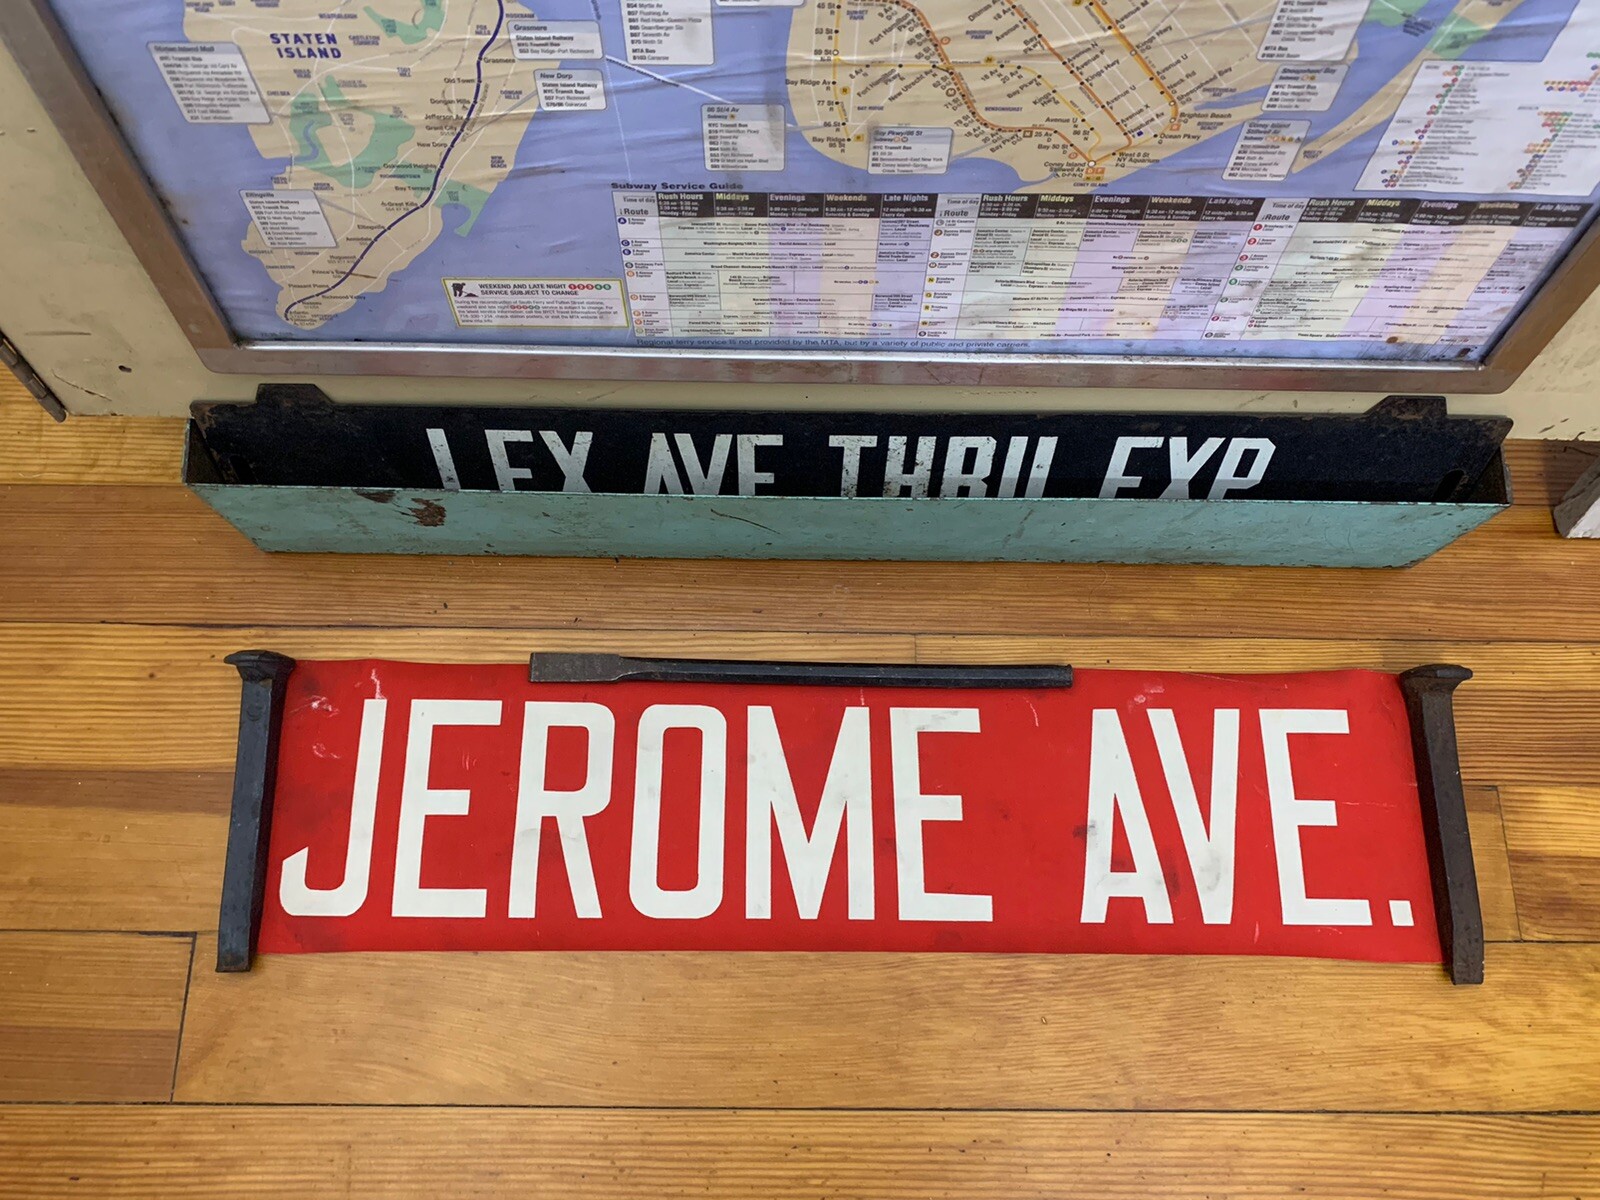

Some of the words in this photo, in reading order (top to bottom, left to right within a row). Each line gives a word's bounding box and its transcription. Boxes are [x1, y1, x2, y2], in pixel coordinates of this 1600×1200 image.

[1115, 6, 1141, 25] Avenue
[269, 33, 338, 45] STATEN
[1136, 34, 1156, 50] Kings
[277, 47, 342, 59] ISLAND
[1156, 59, 1181, 76] Avenue
[1085, 68, 1105, 83] Kings
[800, 79, 822, 87] Ridge
[1019, 77, 1038, 92] Pkwy
[1032, 92, 1052, 106] Kings
[1179, 112, 1208, 120] Brighton
[1044, 161, 1062, 169] Coney
[610, 182, 658, 191] Subway
[661, 182, 707, 190] Service
[709, 182, 744, 190] Guide
[715, 193, 750, 201] Middays
[769, 194, 806, 202] Evenings
[902, 194, 929, 202] Nights
[1040, 195, 1074, 203] Middays
[1150, 196, 1193, 204] Weekends
[1208, 197, 1226, 205] Late
[1227, 198, 1254, 206] Nights
[1331, 199, 1355, 207] Hours
[1366, 199, 1401, 207] Middays
[1421, 201, 1459, 209] Evenings
[1293, 202, 1305, 210] day
[943, 209, 969, 217] Route
[1264, 213, 1290, 221] Route
[754, 338, 791, 347] provided
[792, 339, 803, 347] by
[860, 339, 870, 348] by
[880, 340, 908, 348] variety
[920, 340, 946, 348] public
[947, 340, 965, 348] and
[965, 341, 995, 349] private
[426, 427, 595, 494] LEX
[643, 431, 784, 498] AVE
[1098, 435, 1277, 500] EXP
[279, 698, 993, 922] JEROME
[1080, 707, 1415, 927] AVE.
